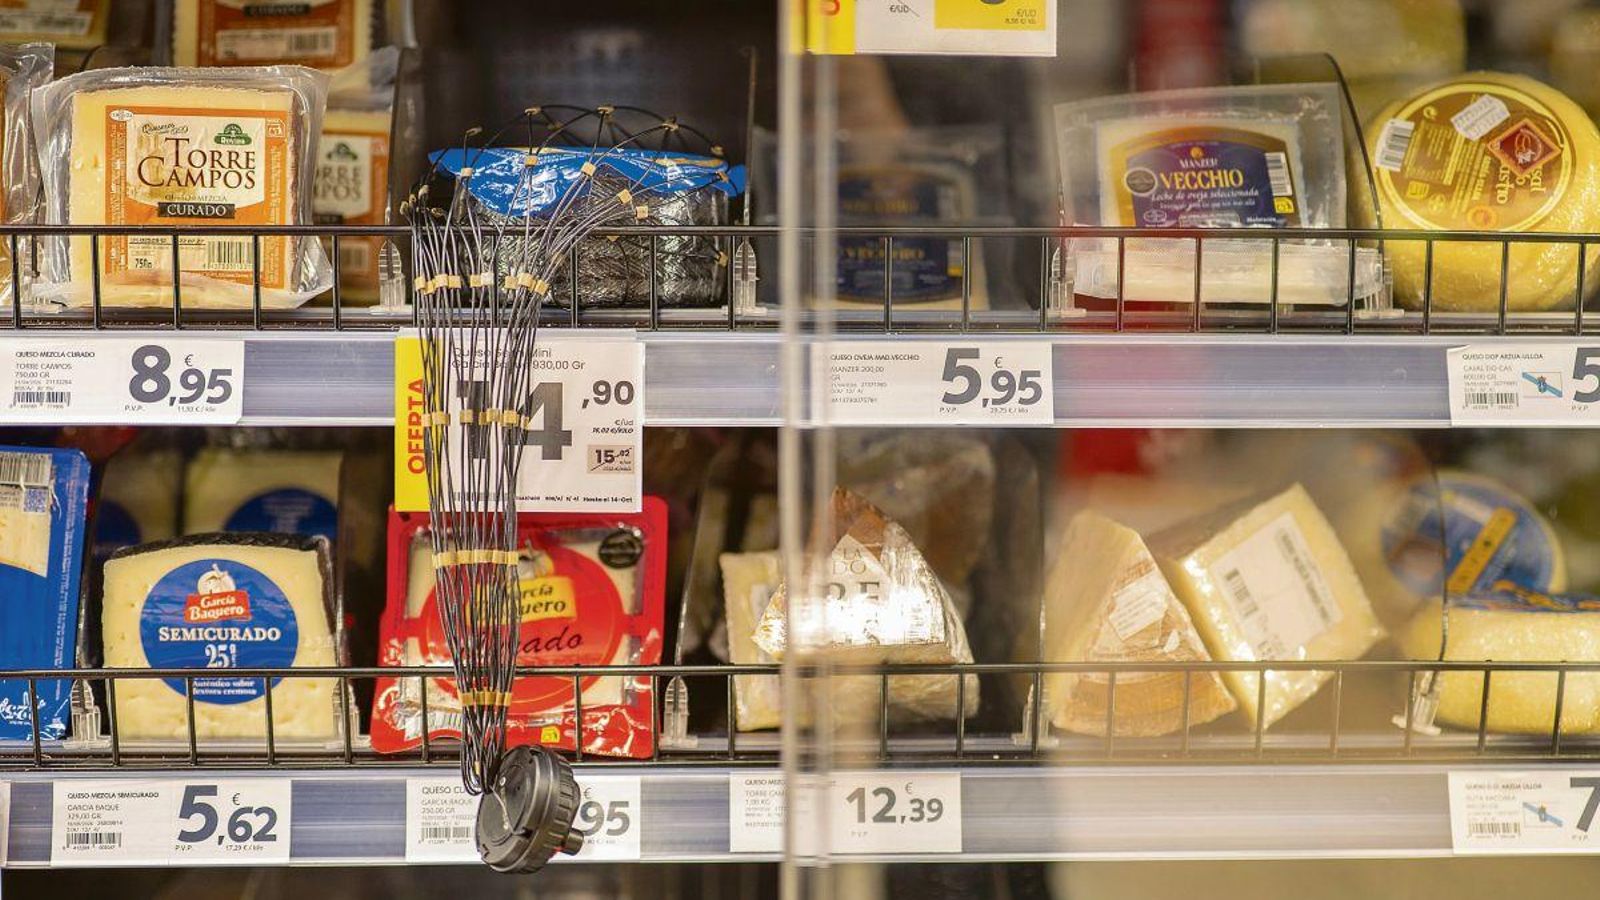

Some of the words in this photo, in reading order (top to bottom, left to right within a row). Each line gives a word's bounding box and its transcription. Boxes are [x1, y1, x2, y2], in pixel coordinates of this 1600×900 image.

[165, 137, 256, 170] TORRE
[137, 155, 256, 189] CAMPOS
[1159, 168, 1244, 190] VECCHIO
[167, 204, 227, 217] CURADO
[184, 353, 194, 367] €
[533, 360, 570, 371] 930,00
[572, 360, 586, 370] Gr
[994, 356, 1004, 369] €
[129, 344, 233, 406] 8,95
[941, 347, 1044, 408] 5,95
[407, 379, 426, 474] OFERTA
[522, 584, 553, 599] rcía
[200, 594, 236, 609] García
[520, 600, 567, 615] uero
[189, 604, 244, 621] Baquero
[158, 627, 281, 642] SEMICURADO
[522, 626, 583, 654] ado
[422, 786, 451, 794] QUESO
[454, 786, 466, 794] CU
[583, 787, 592, 800] €
[905, 781, 913, 794] €
[232, 792, 241, 806] €
[846, 787, 944, 824] 12,39
[177, 785, 277, 846] 5,62
[579, 801, 630, 837] 95
